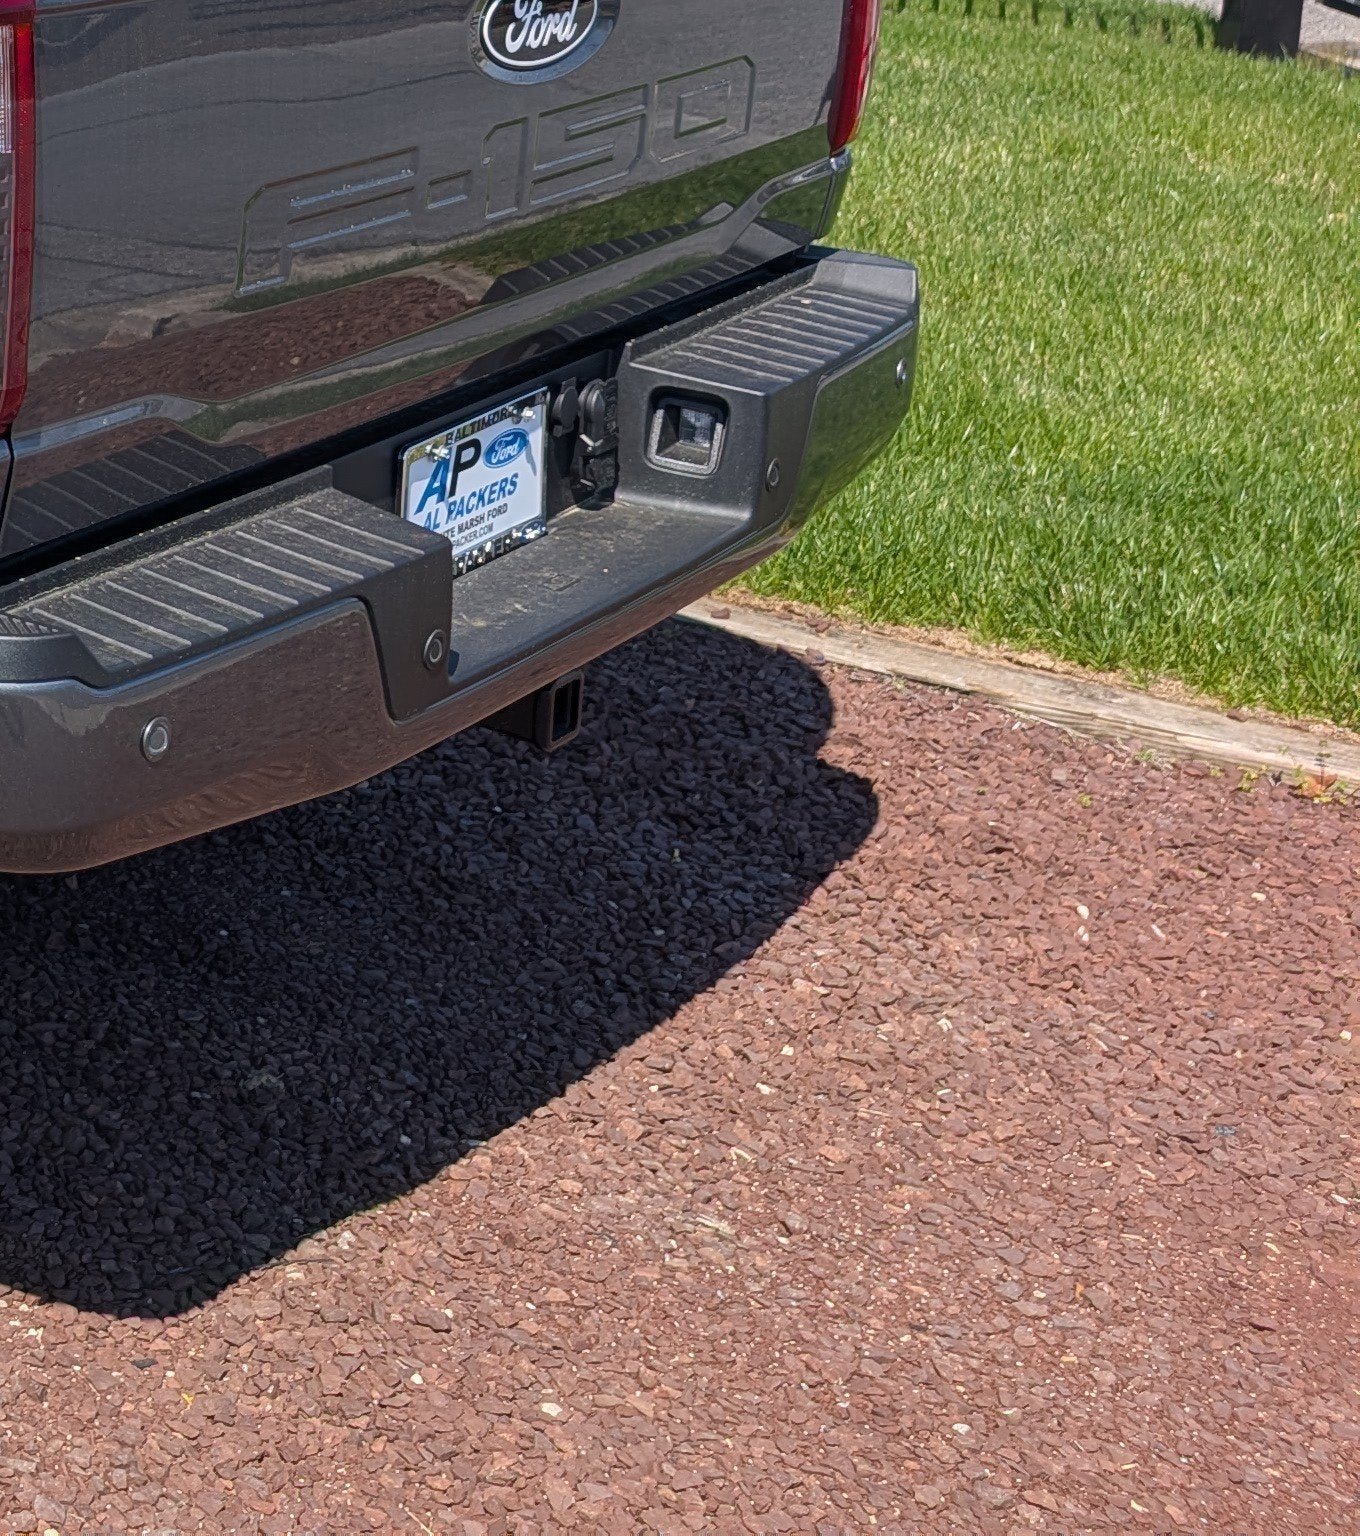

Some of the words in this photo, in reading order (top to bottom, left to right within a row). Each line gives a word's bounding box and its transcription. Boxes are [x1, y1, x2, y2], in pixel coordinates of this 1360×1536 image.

[236, 55, 755, 295] F-150
[490, 434, 522, 464] Ford
[423, 507, 441, 531] AL
[445, 472, 519, 525] PACKERS
[457, 513, 485, 535] MARSH
[486, 502, 509, 525] FORD
